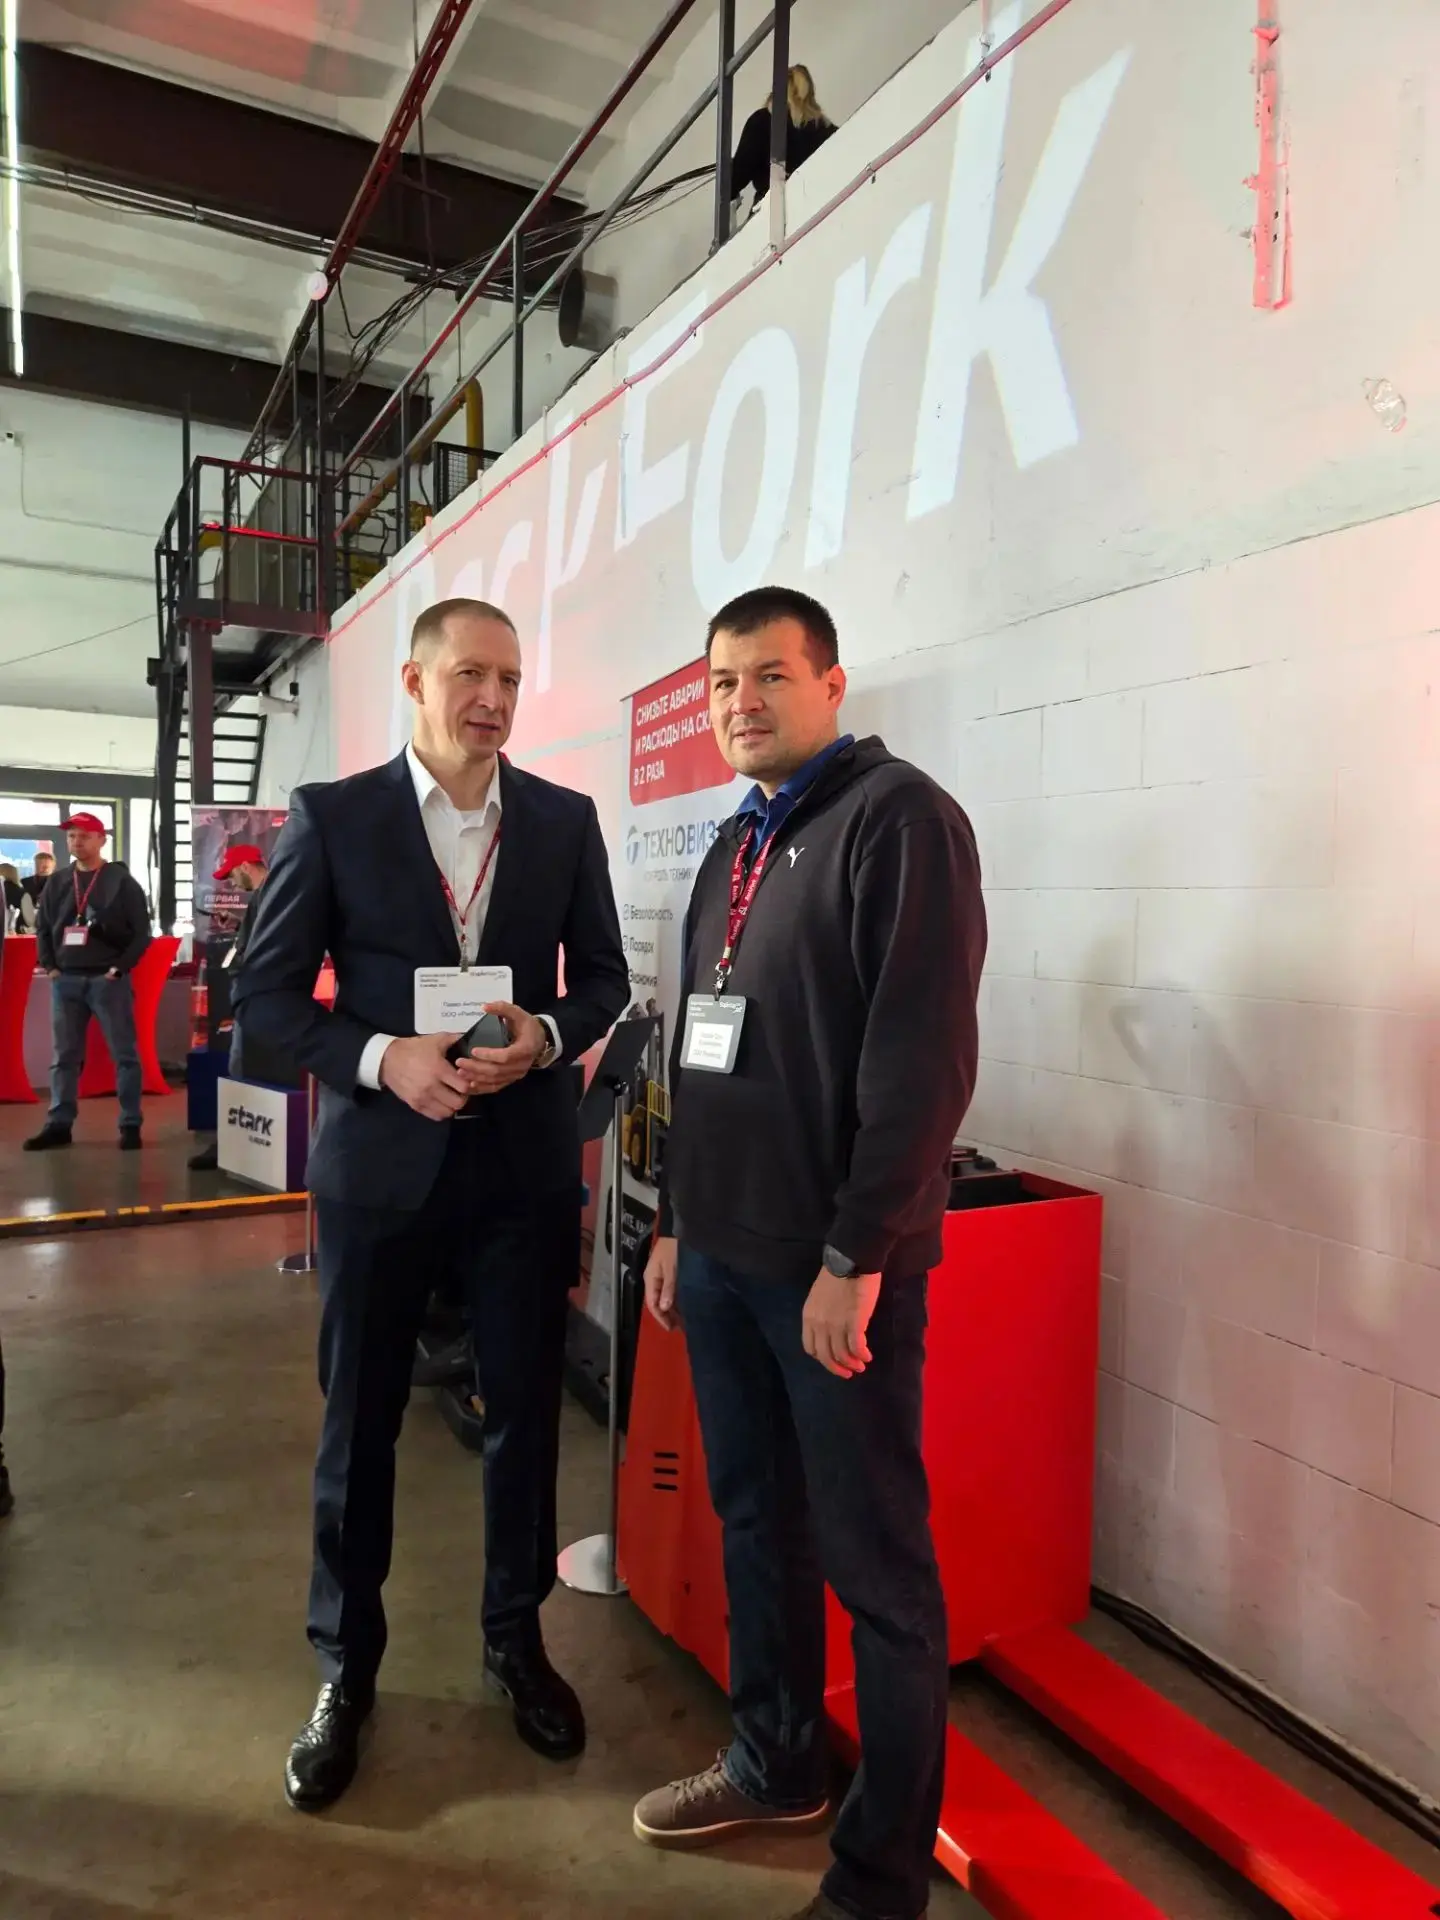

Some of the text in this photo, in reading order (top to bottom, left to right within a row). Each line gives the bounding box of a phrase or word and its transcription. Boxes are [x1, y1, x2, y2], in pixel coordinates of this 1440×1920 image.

[636, 676, 705, 727] СНИЗЬТЕ АВАРИИ
[634, 736, 641, 757] И
[641, 722, 681, 754] РАСХОДЫ
[681, 716, 695, 740] НА
[633, 759, 665, 786] В 2 РАЗА
[631, 904, 674, 921] Безопасность
[227, 1104, 274, 1137] stark
